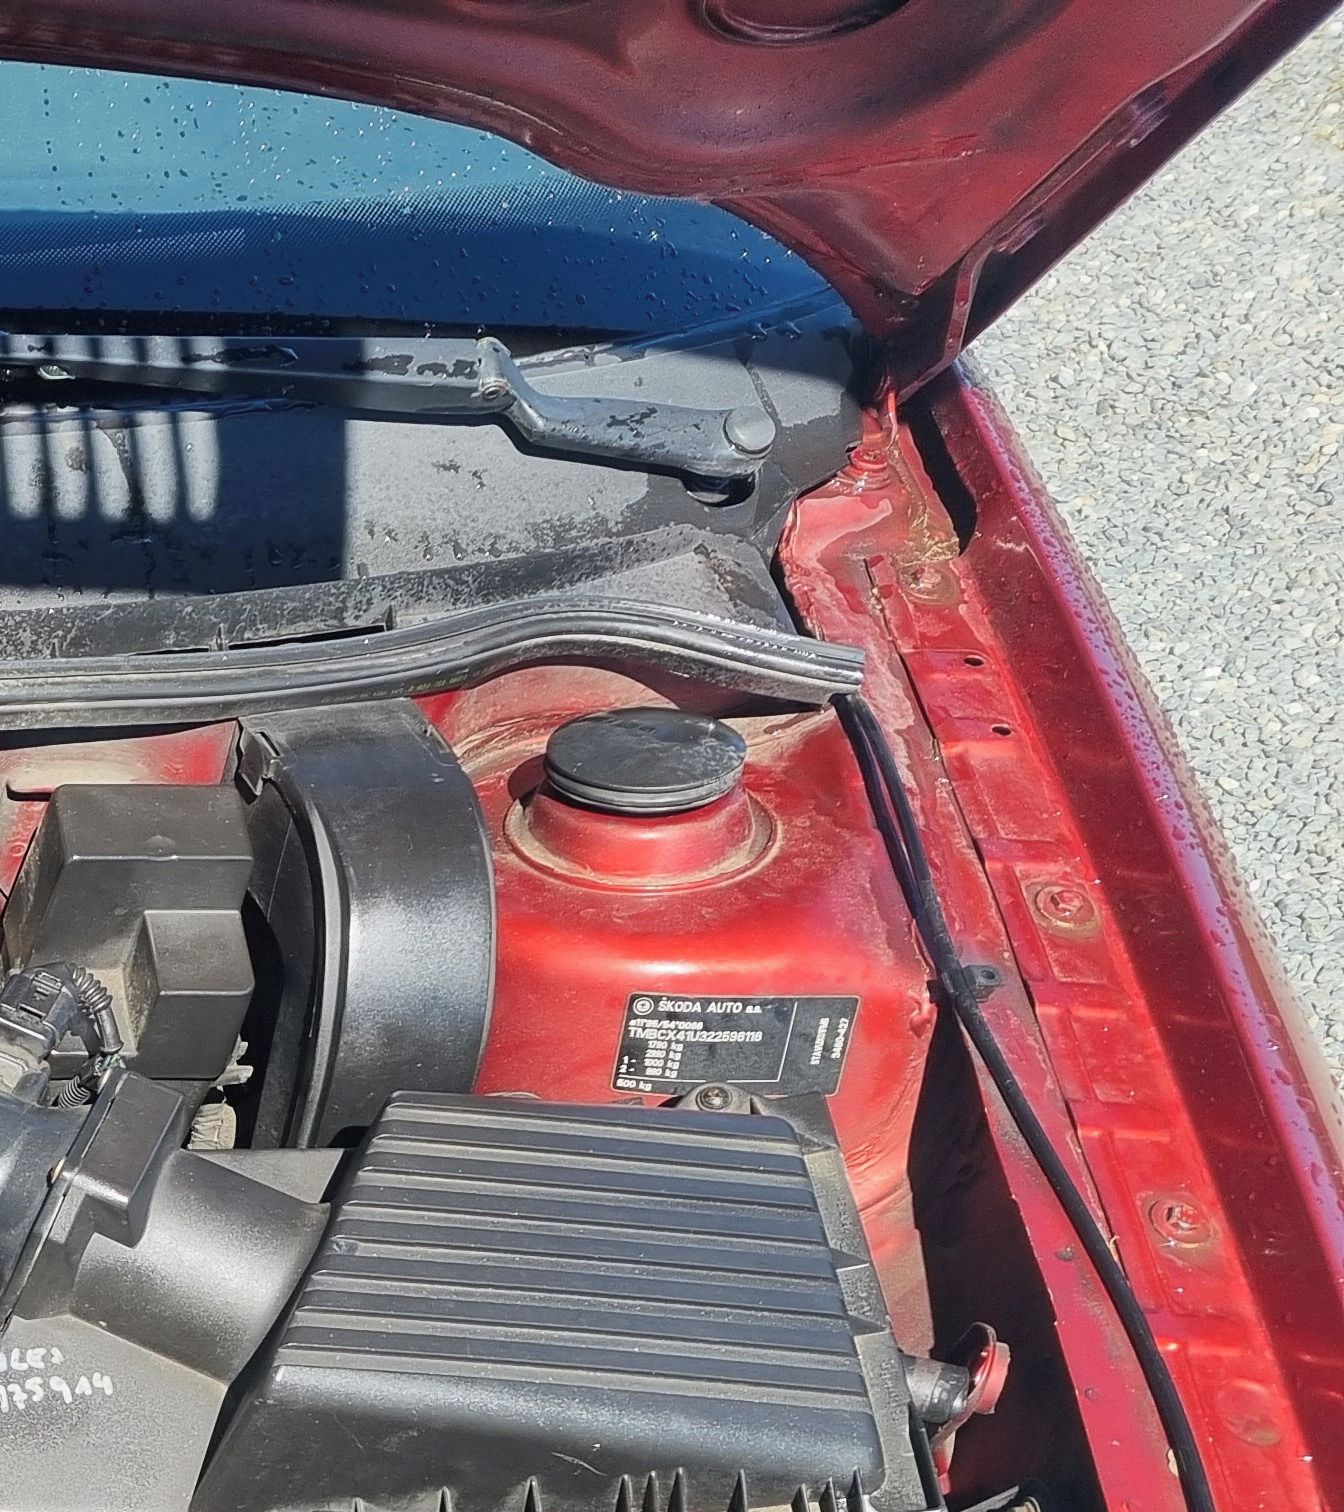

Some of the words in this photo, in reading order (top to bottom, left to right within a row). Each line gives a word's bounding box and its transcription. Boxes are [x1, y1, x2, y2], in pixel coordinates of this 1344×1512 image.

[658, 997, 702, 1013] ŠKODA
[707, 1001, 743, 1014] AUTO
[670, 1041, 684, 1052] kg
[668, 1050, 682, 1061] kg
[666, 1060, 680, 1070] kg
[664, 1068, 678, 1078] kg
[638, 1081, 652, 1091] kg
